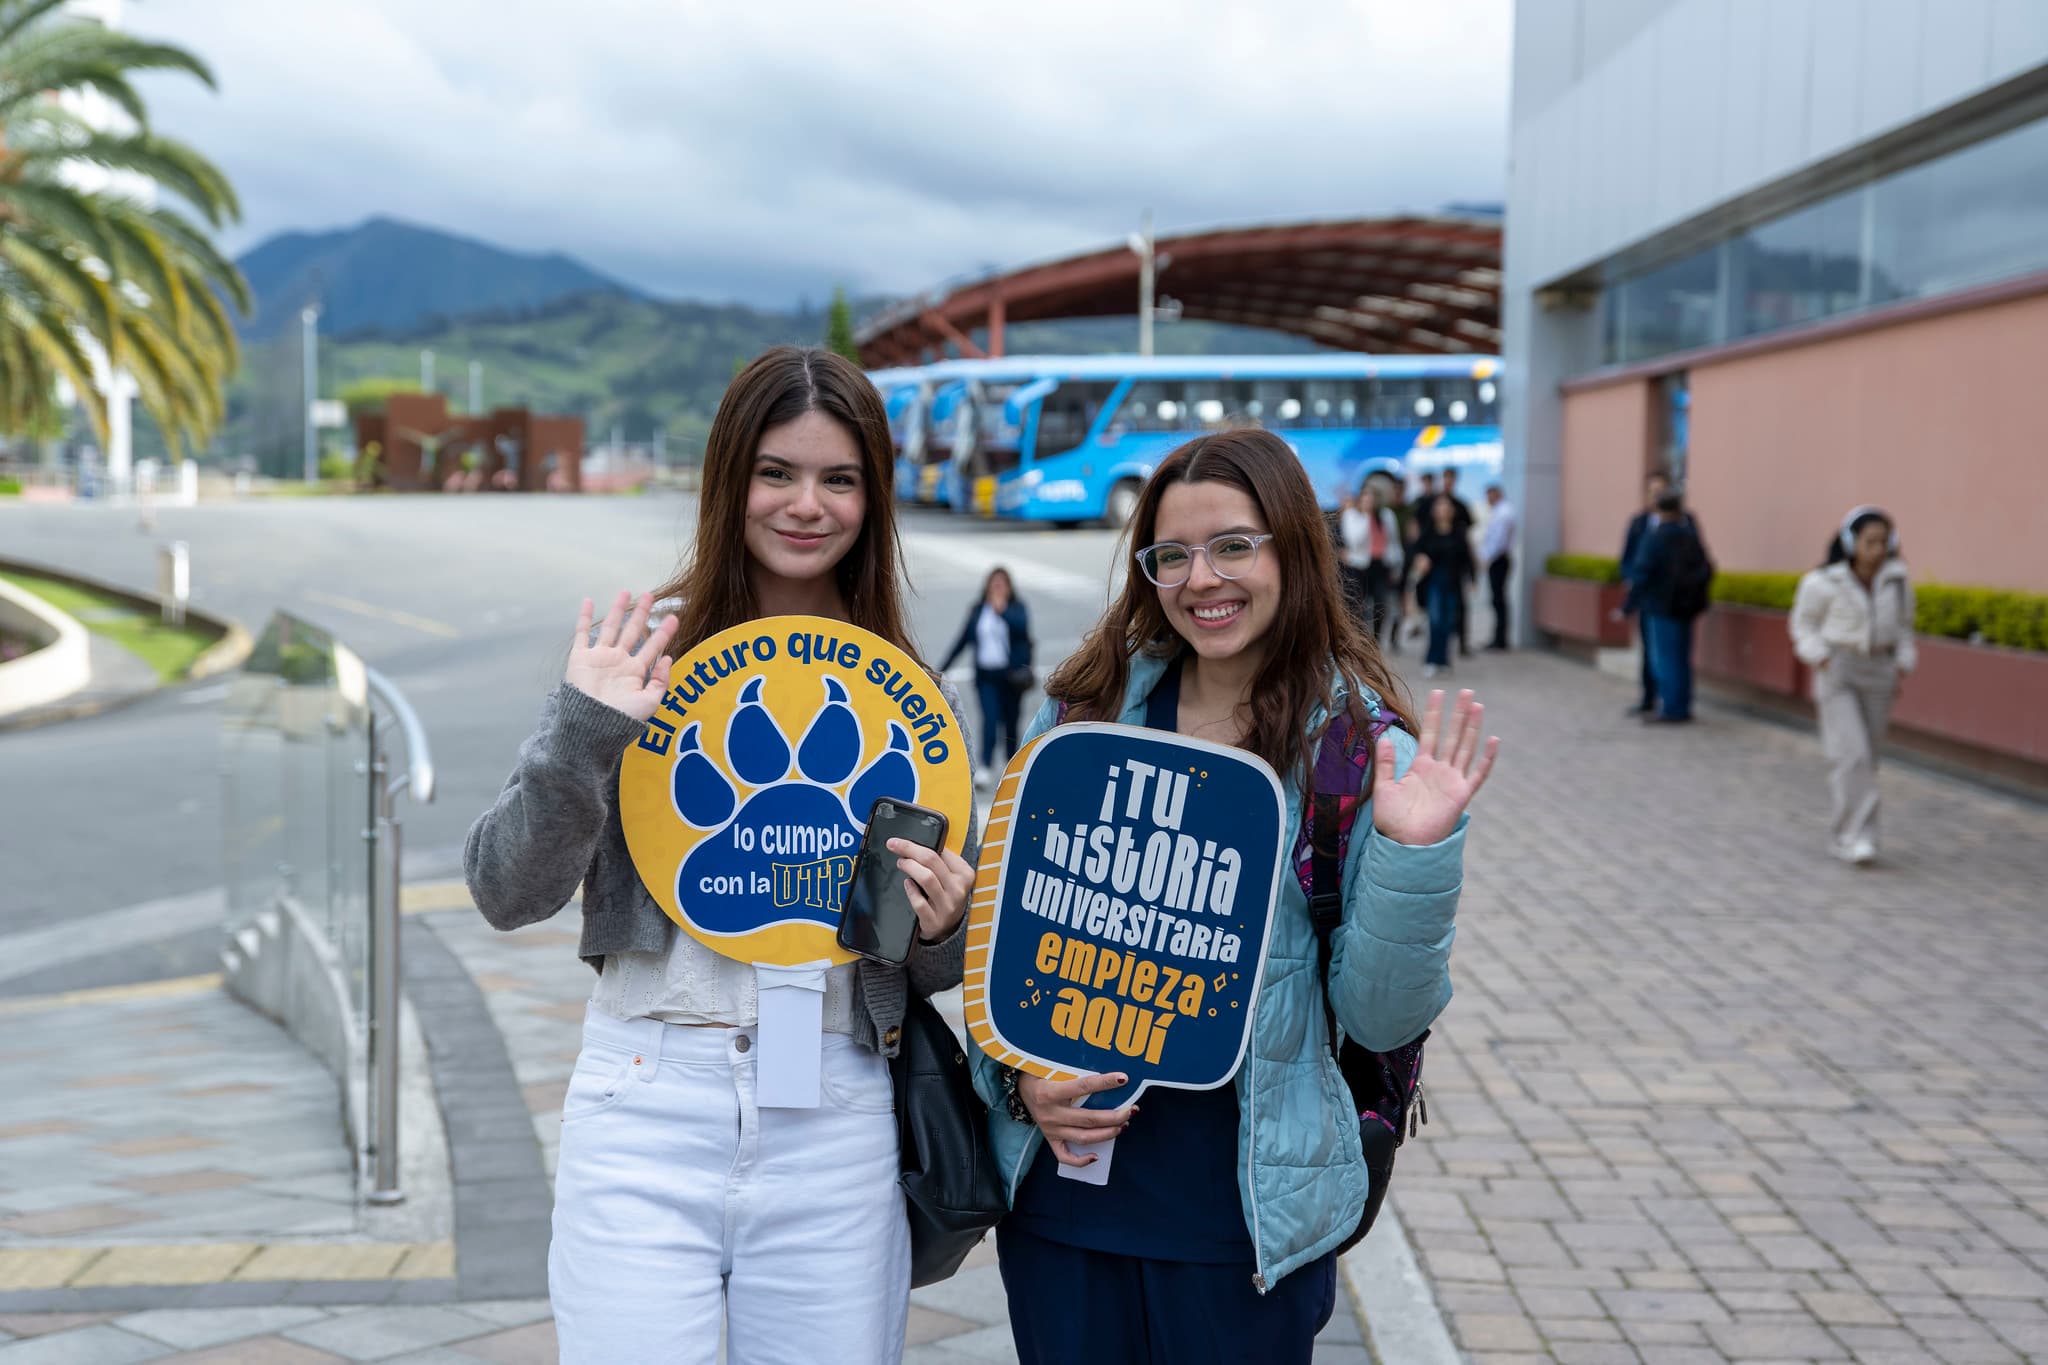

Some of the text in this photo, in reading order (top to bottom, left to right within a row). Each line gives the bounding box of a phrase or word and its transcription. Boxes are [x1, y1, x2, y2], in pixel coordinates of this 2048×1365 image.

[638, 632, 949, 765] El futuro que sueño
[733, 823, 854, 859] lo cumplo
[699, 855, 859, 913] con la UTP
